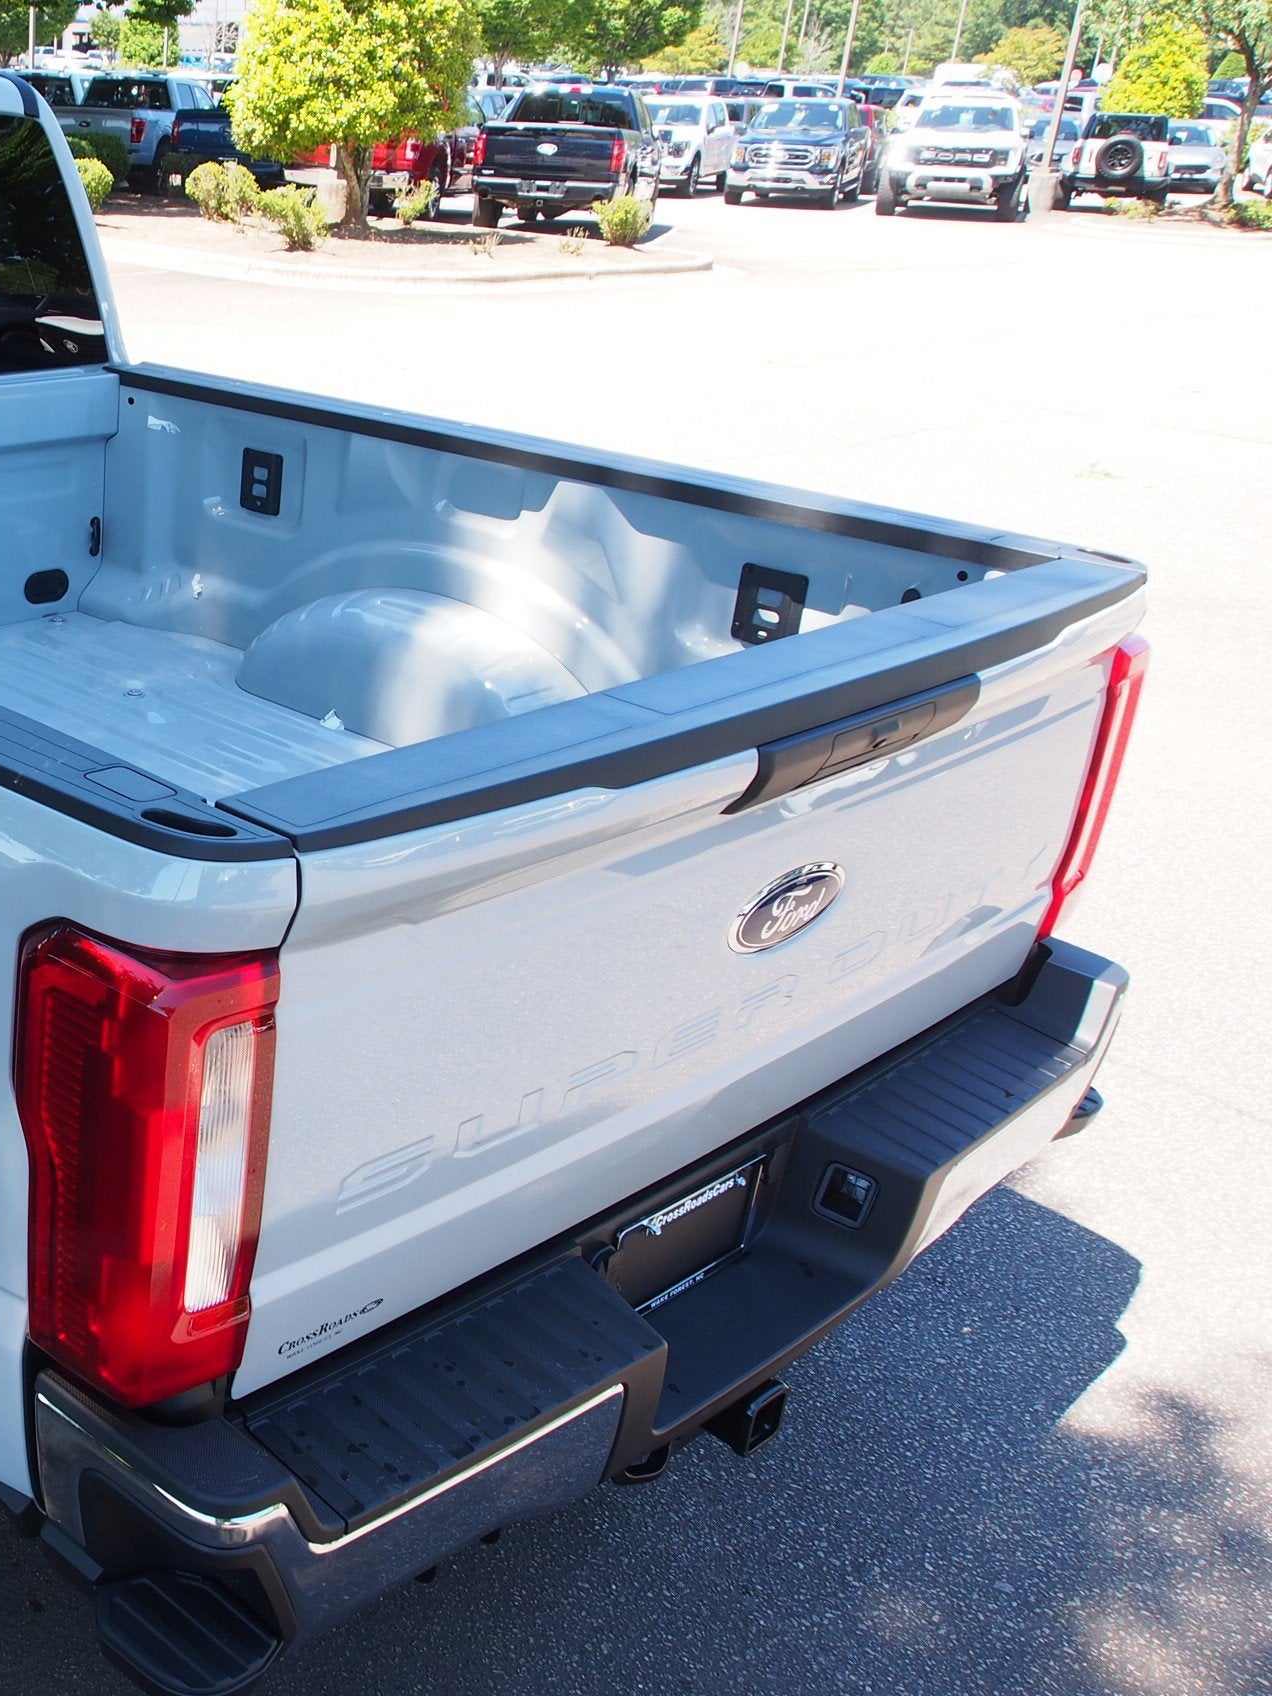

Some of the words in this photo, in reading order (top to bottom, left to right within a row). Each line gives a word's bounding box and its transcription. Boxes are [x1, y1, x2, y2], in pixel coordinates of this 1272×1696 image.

[336, 974, 798, 1215] SUPER
[655, 1178, 735, 1227] CrossRoadsCars
[650, 1293, 670, 1308] WAKE
[695, 1272, 705, 1282] NC
